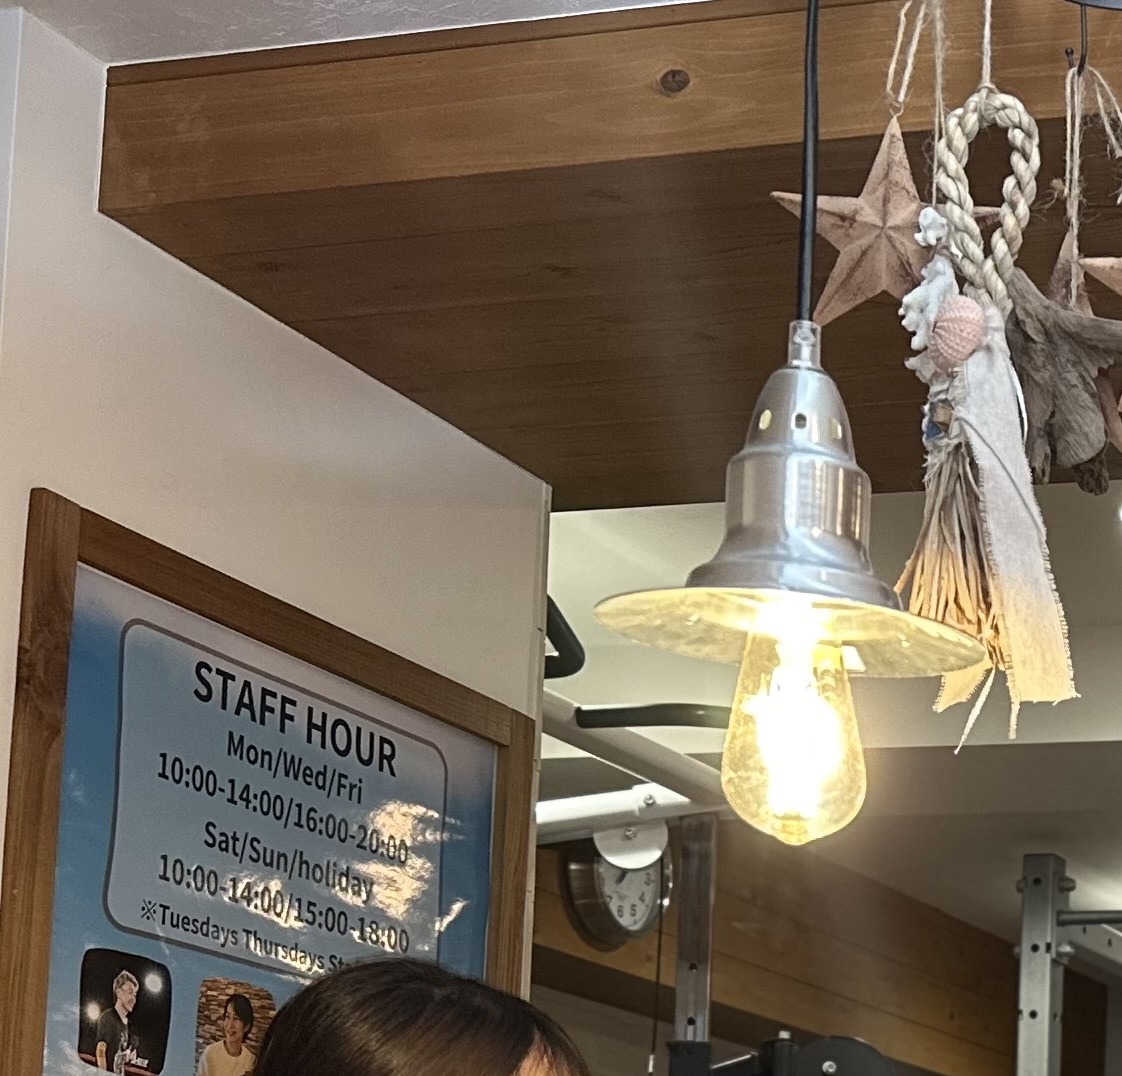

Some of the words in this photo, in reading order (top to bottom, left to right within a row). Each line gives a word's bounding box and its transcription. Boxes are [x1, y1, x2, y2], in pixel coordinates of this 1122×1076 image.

[193, 660, 297, 734] STAFF
[306, 705, 397, 777] HOUR
[158, 753, 408, 864] 10:00-14:00/16:00-20:00
[227, 730, 363, 804] Mon/Wed/Fri
[159, 854, 409, 953] 10:00-14:00/15:00-18:00
[204, 821, 374, 904] Sat/Sun/holiday
[243, 928, 325, 972] Thursdays
